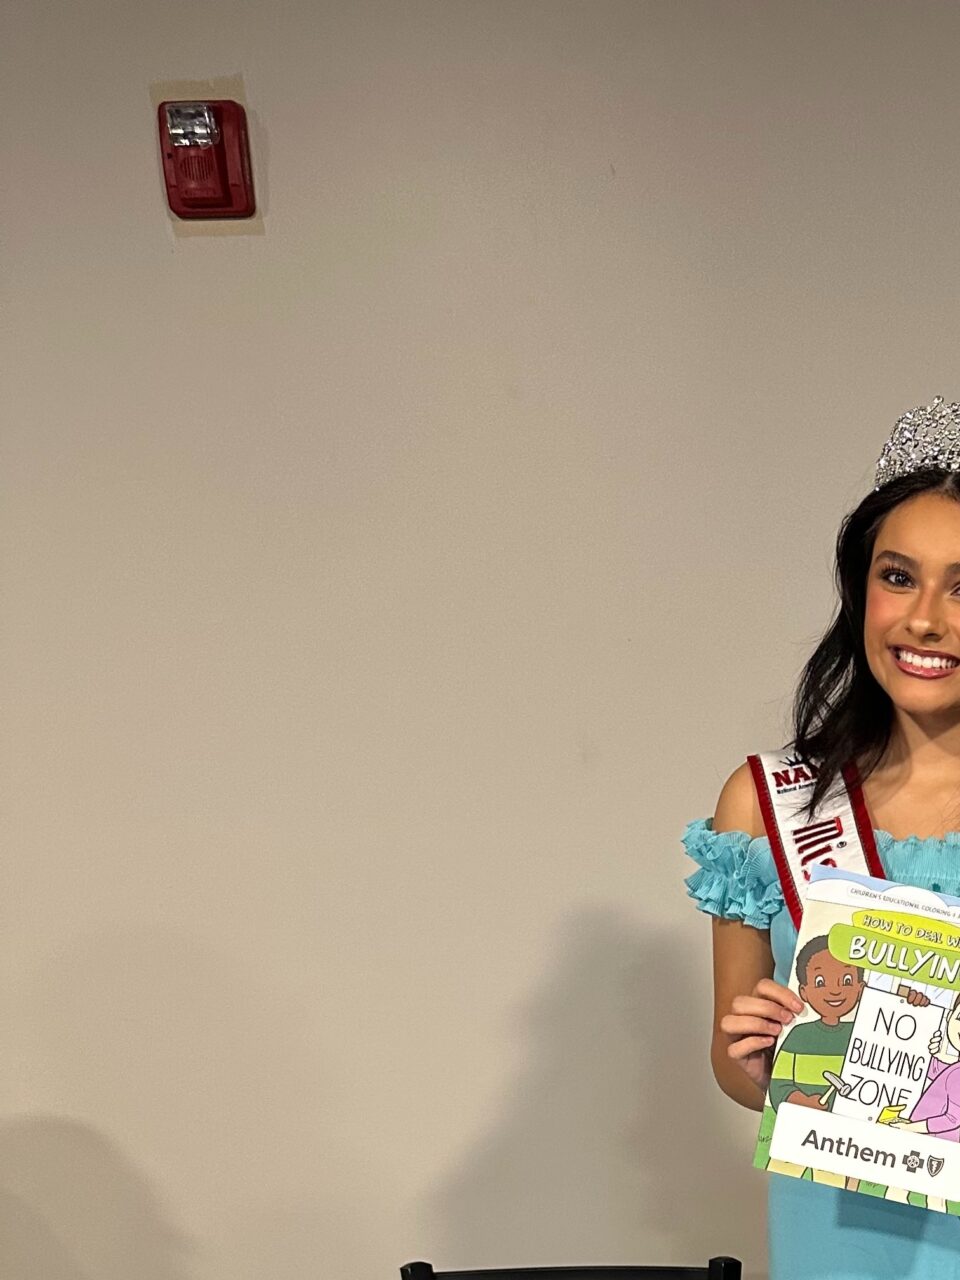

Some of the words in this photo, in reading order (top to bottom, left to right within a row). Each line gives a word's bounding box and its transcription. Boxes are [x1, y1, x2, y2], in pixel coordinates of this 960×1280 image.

[850, 887, 882, 900] CHILDREN'S
[882, 894, 921, 911] EDUCATIONAL
[922, 904, 952, 917] COLORING
[862, 914, 894, 932] HOW
[896, 922, 913, 936] TO
[915, 928, 943, 944] DEAL
[873, 1007, 917, 1041] NO
[849, 1037, 926, 1082] BULLYING
[801, 1129, 896, 1168] Anthem
